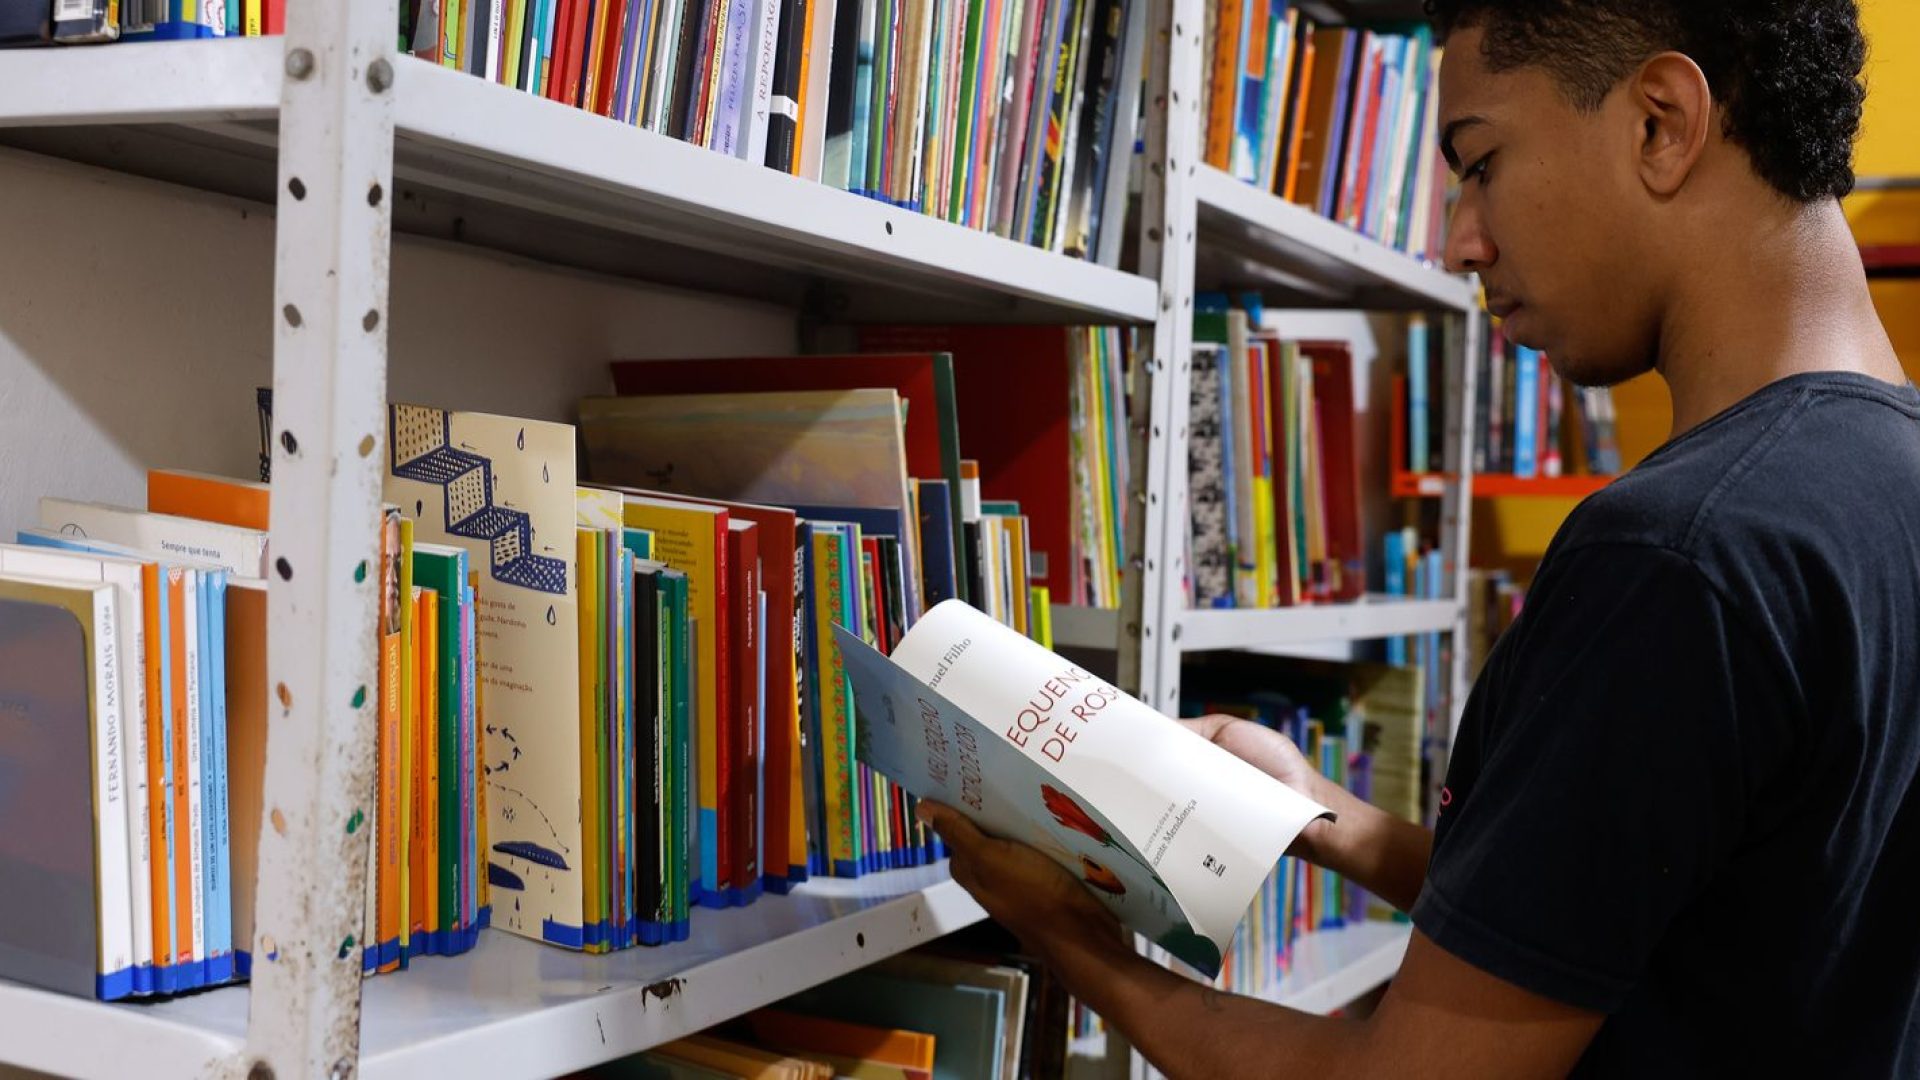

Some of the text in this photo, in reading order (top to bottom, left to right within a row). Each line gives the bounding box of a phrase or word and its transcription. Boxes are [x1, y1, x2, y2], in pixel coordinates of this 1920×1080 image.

[727, 62, 738, 111] FELIZES
[733, 24, 743, 58] PARA
[757, 0, 776, 122] A REPORTAG
[161, 539, 221, 559] Sempre que tenta
[102, 644, 116, 707] MORAIS
[389, 643, 399, 713] verissimo
[929, 639, 971, 688] nuel Filho
[106, 714, 120, 802] FERNANDO
[1041, 722, 1078, 762] DE
[1162, 798, 1198, 844] Mendonça
